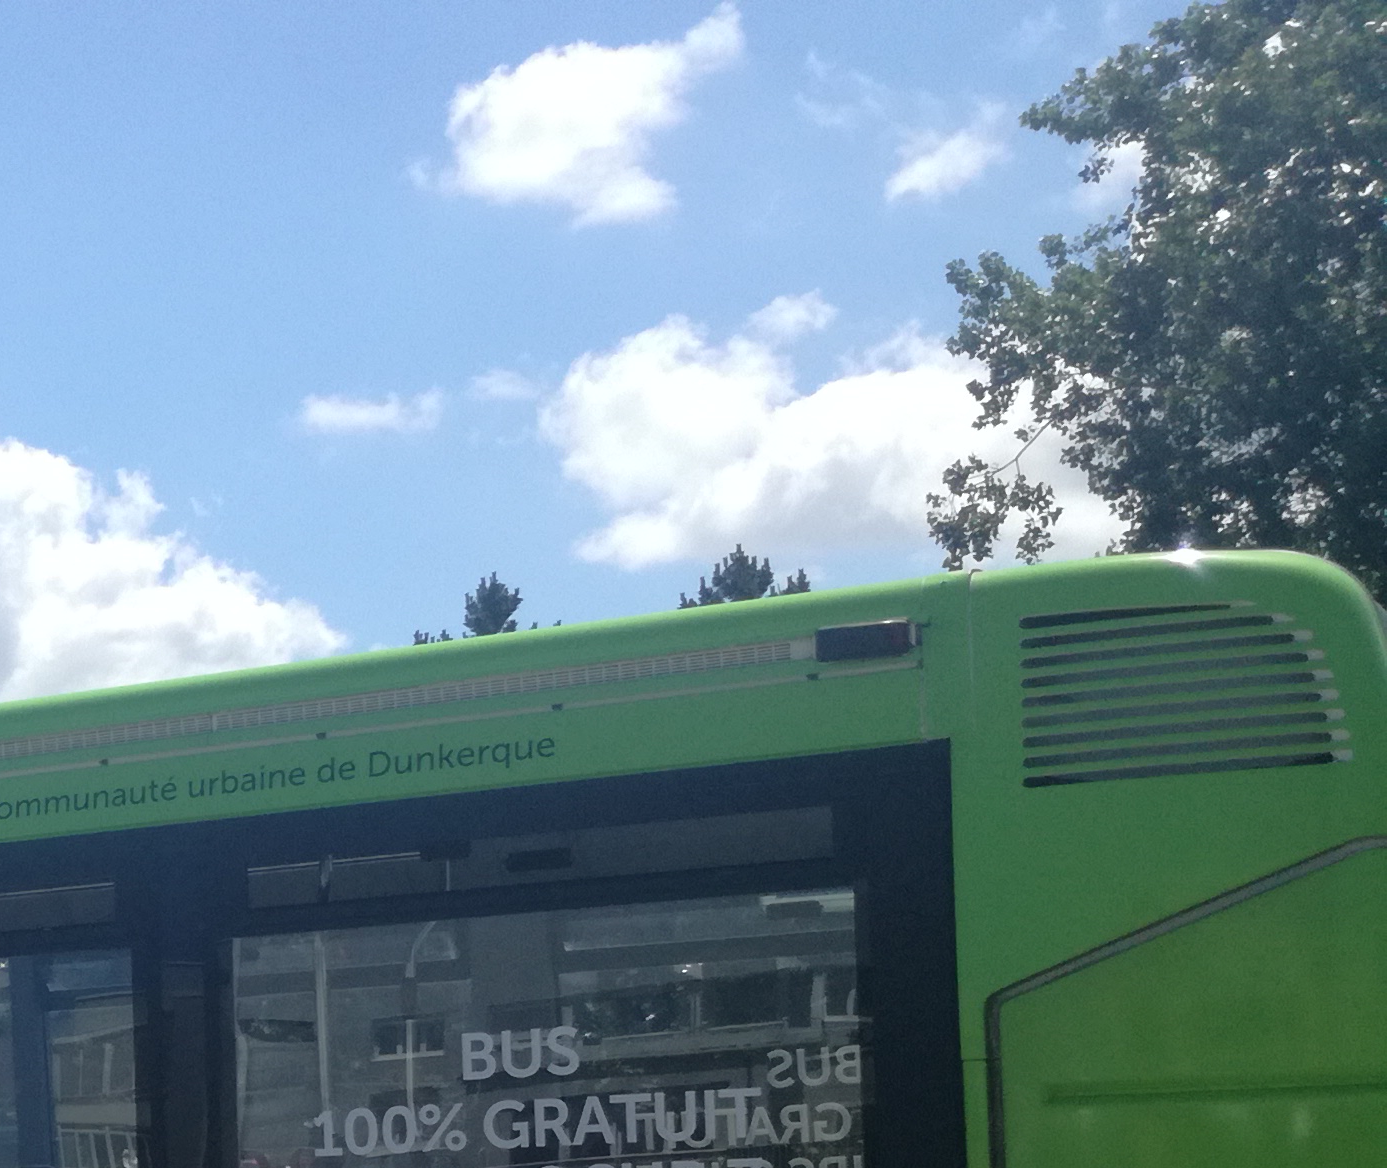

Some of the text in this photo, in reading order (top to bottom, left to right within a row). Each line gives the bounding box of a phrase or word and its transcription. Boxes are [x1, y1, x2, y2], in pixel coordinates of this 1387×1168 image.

[188, 764, 306, 798] urbaine
[316, 757, 356, 784] de
[368, 736, 556, 778] Dunkerque
[461, 1025, 581, 1081] BUS
[313, 1086, 761, 1158] 100% GRATUIT
